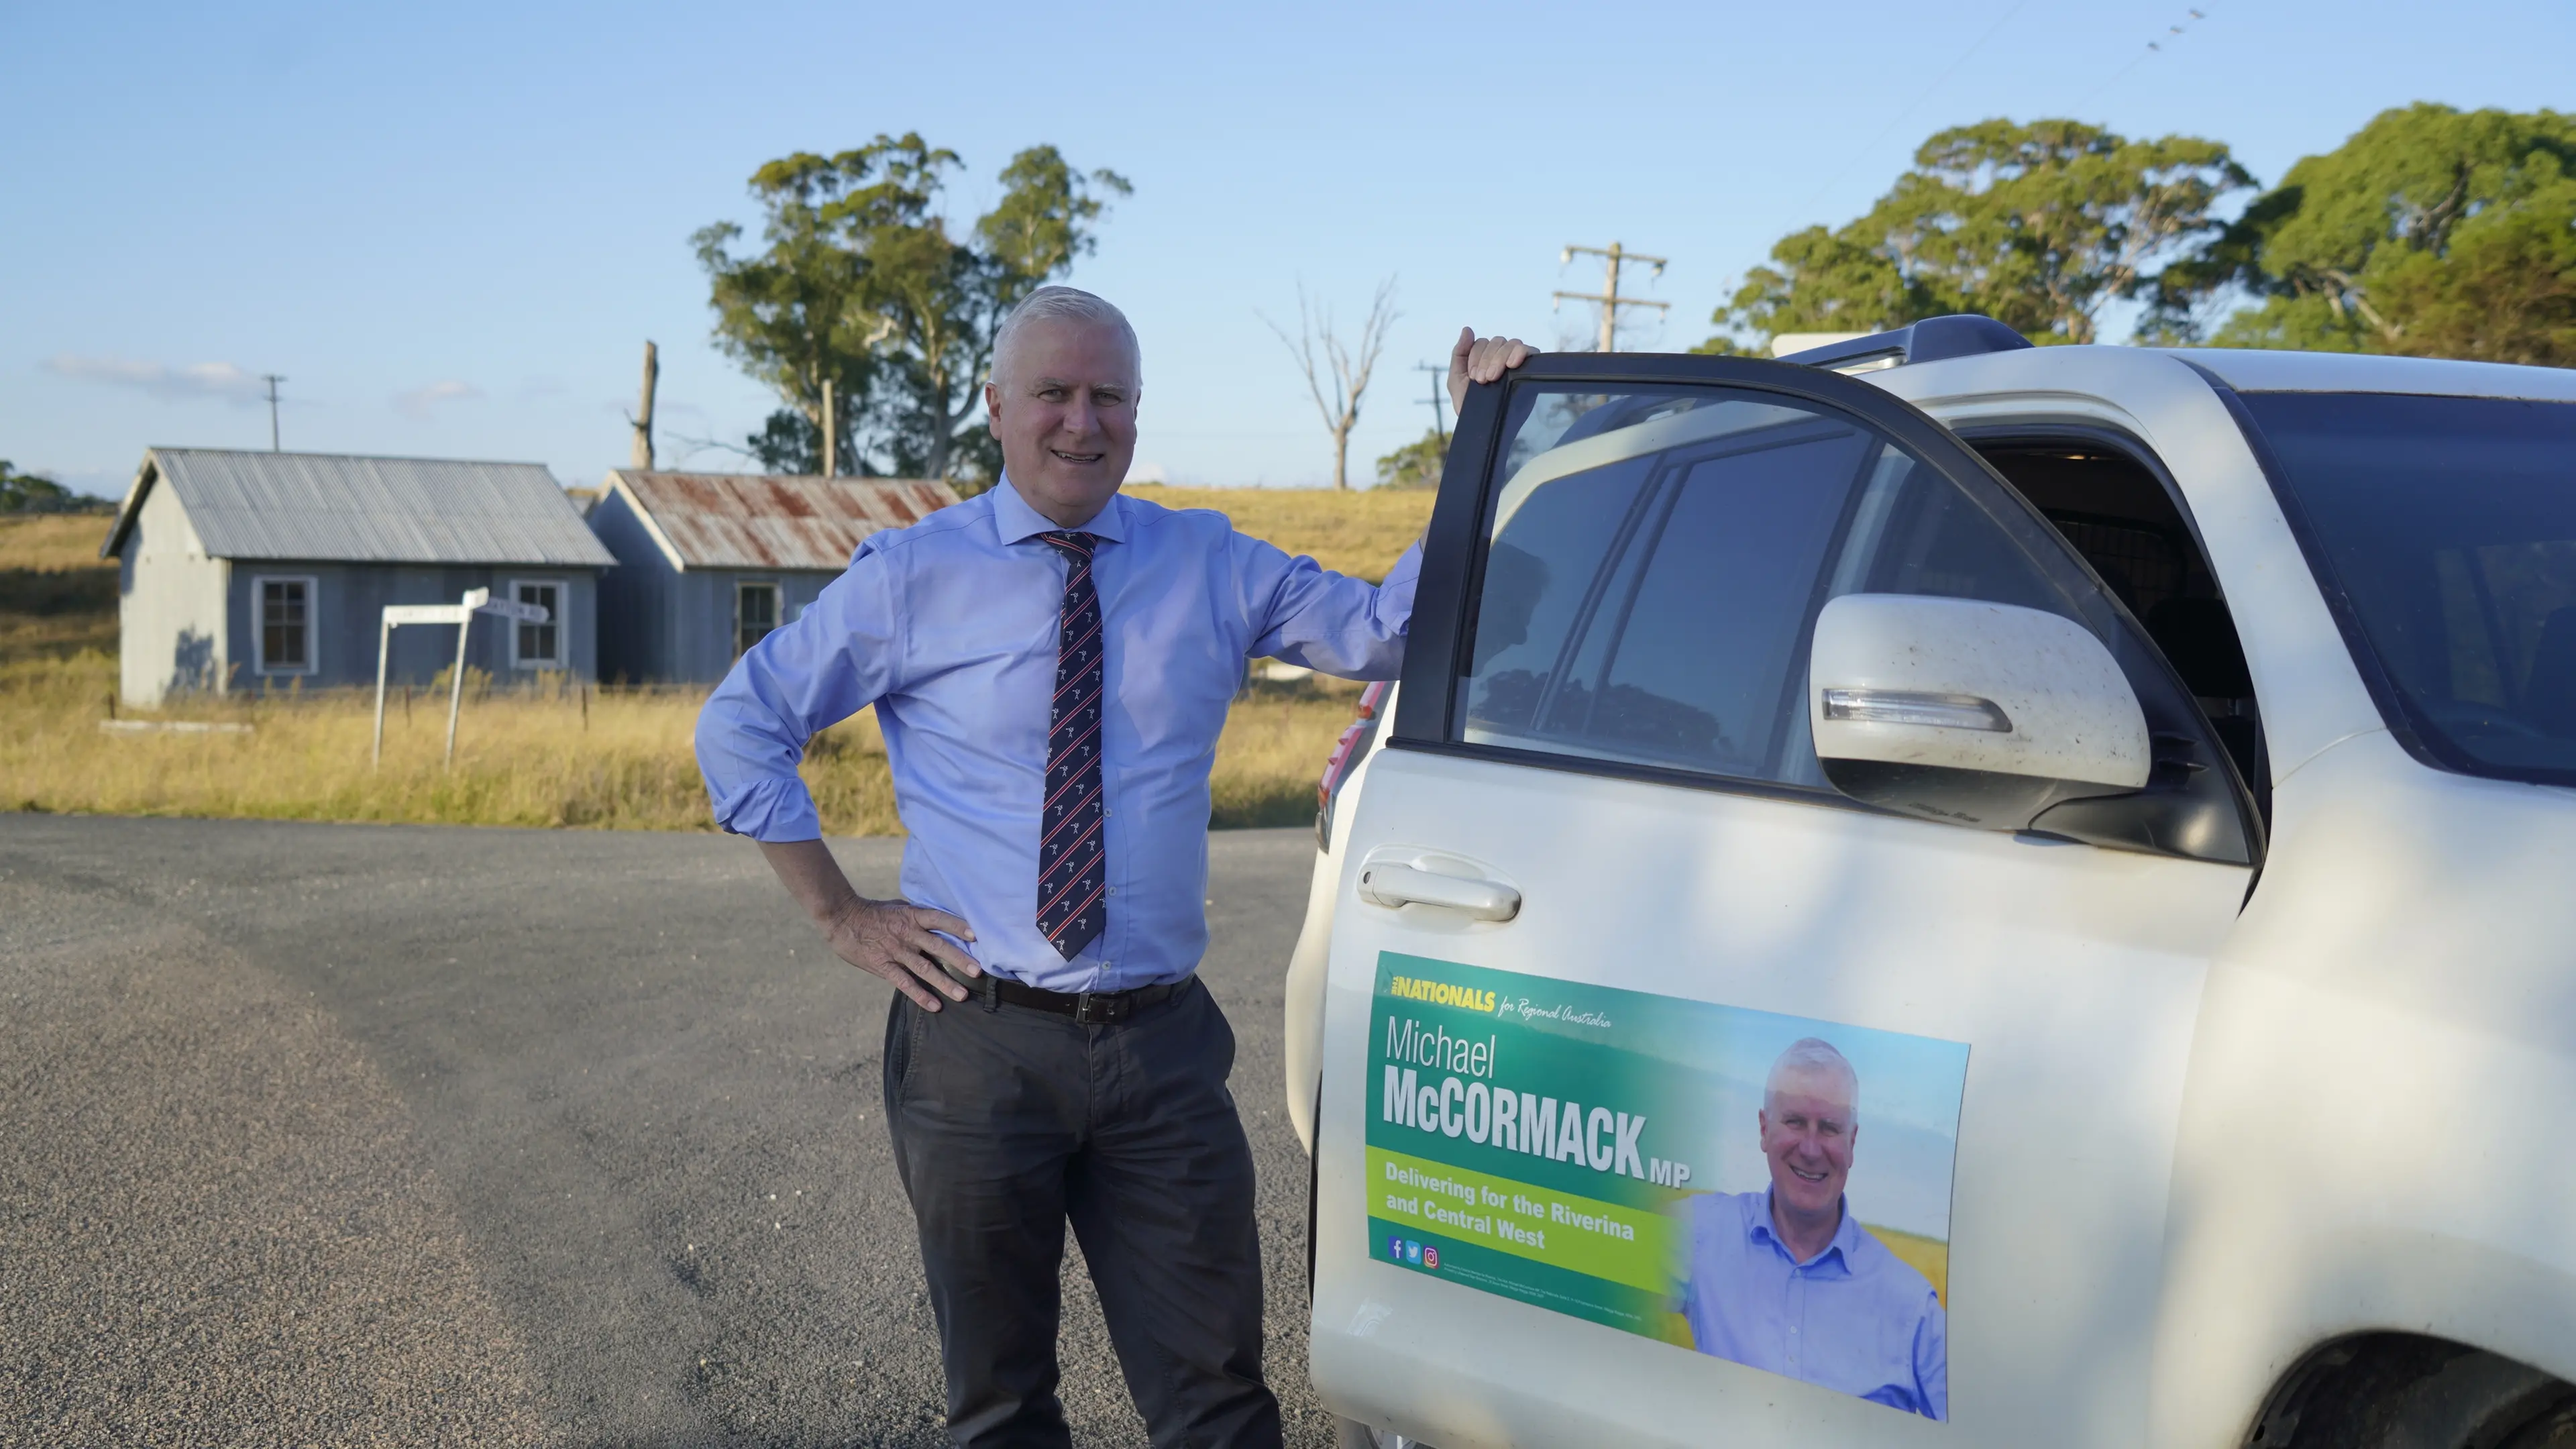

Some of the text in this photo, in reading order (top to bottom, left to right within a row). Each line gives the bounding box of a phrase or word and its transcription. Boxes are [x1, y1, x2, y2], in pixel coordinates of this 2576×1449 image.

[1397, 976, 1496, 1012] NATIONALS
[1497, 996, 1612, 1028] for Regional Australia
[1386, 1016, 1496, 1079] Michael
[1383, 1065, 1691, 1188] McCORMACK MP
[1385, 1162, 1635, 1241] Delivering for the Riverina
[1386, 1194, 1545, 1249] and Central West
